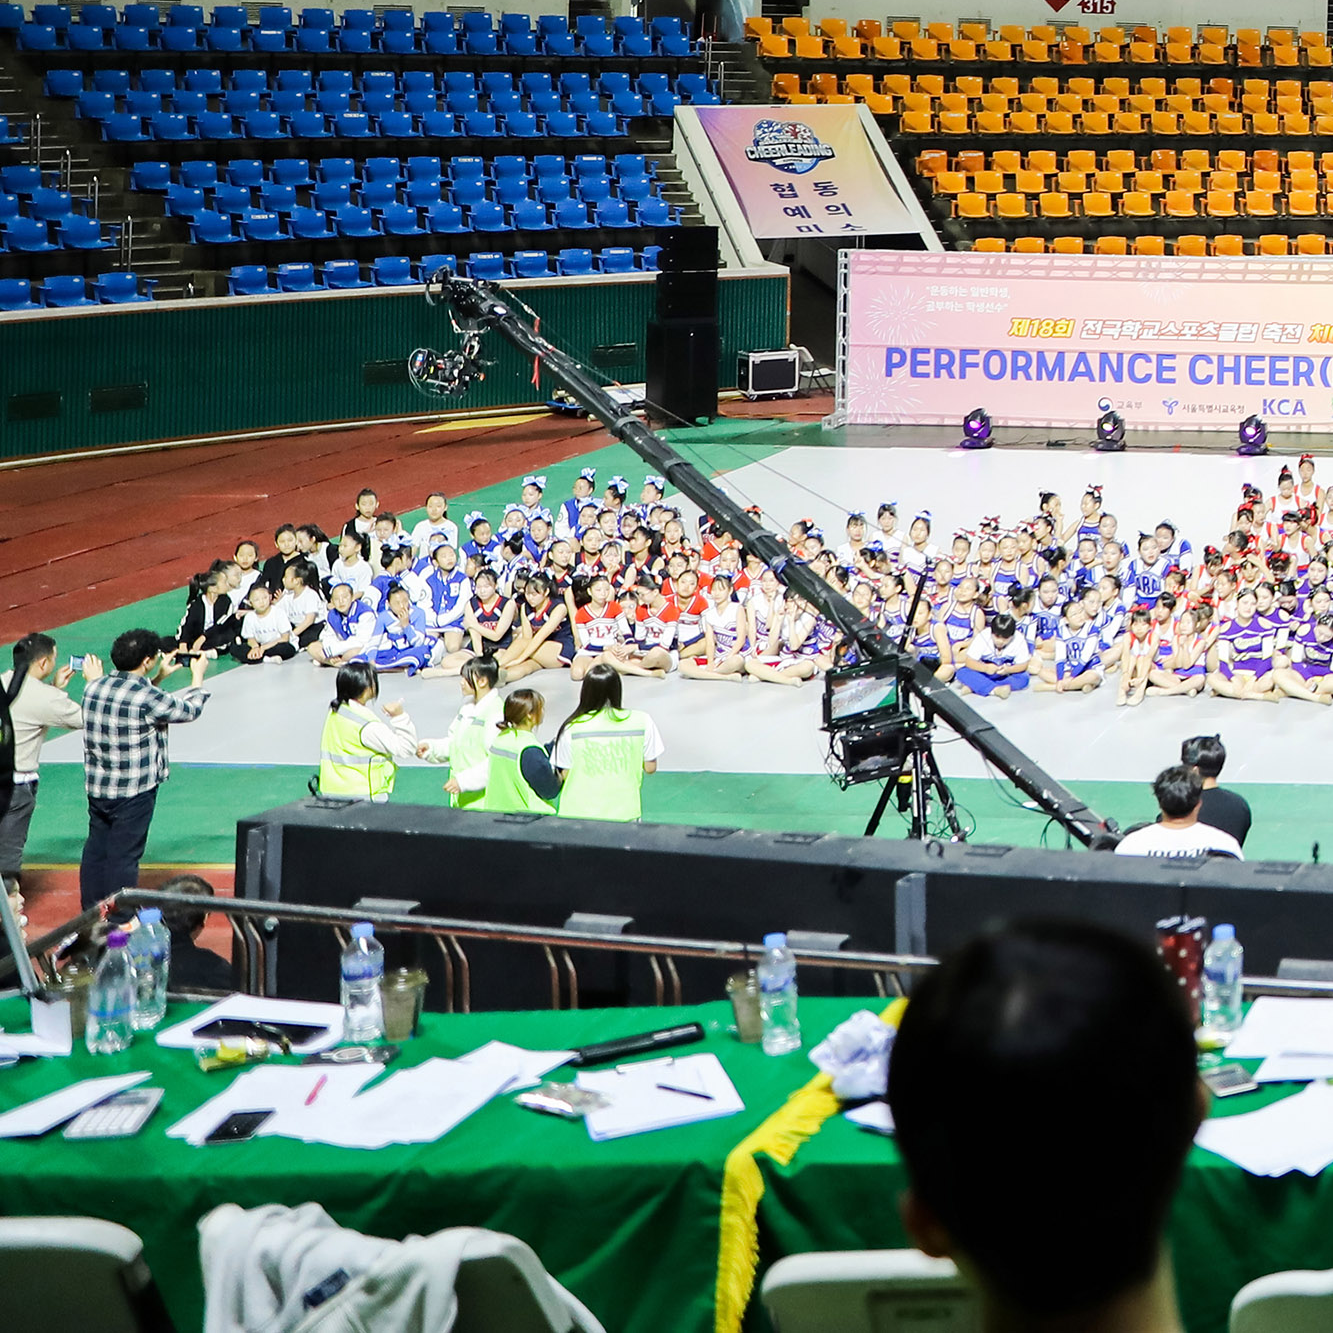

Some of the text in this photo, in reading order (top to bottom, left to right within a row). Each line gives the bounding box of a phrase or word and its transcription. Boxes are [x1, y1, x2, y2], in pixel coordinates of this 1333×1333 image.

[747, 144, 833, 160] CHEERLEADING
[1008, 317, 1076, 339] 제18회
[1079, 318, 1259, 343] 전국학교스포츠클럽
[1261, 322, 1305, 344] 축전
[884, 347, 1177, 385] PERFORMANCE
[1116, 399, 1143, 410] 교육부
[1181, 402, 1246, 414] 서울특별시교육청
[1262, 398, 1307, 416] KCA
